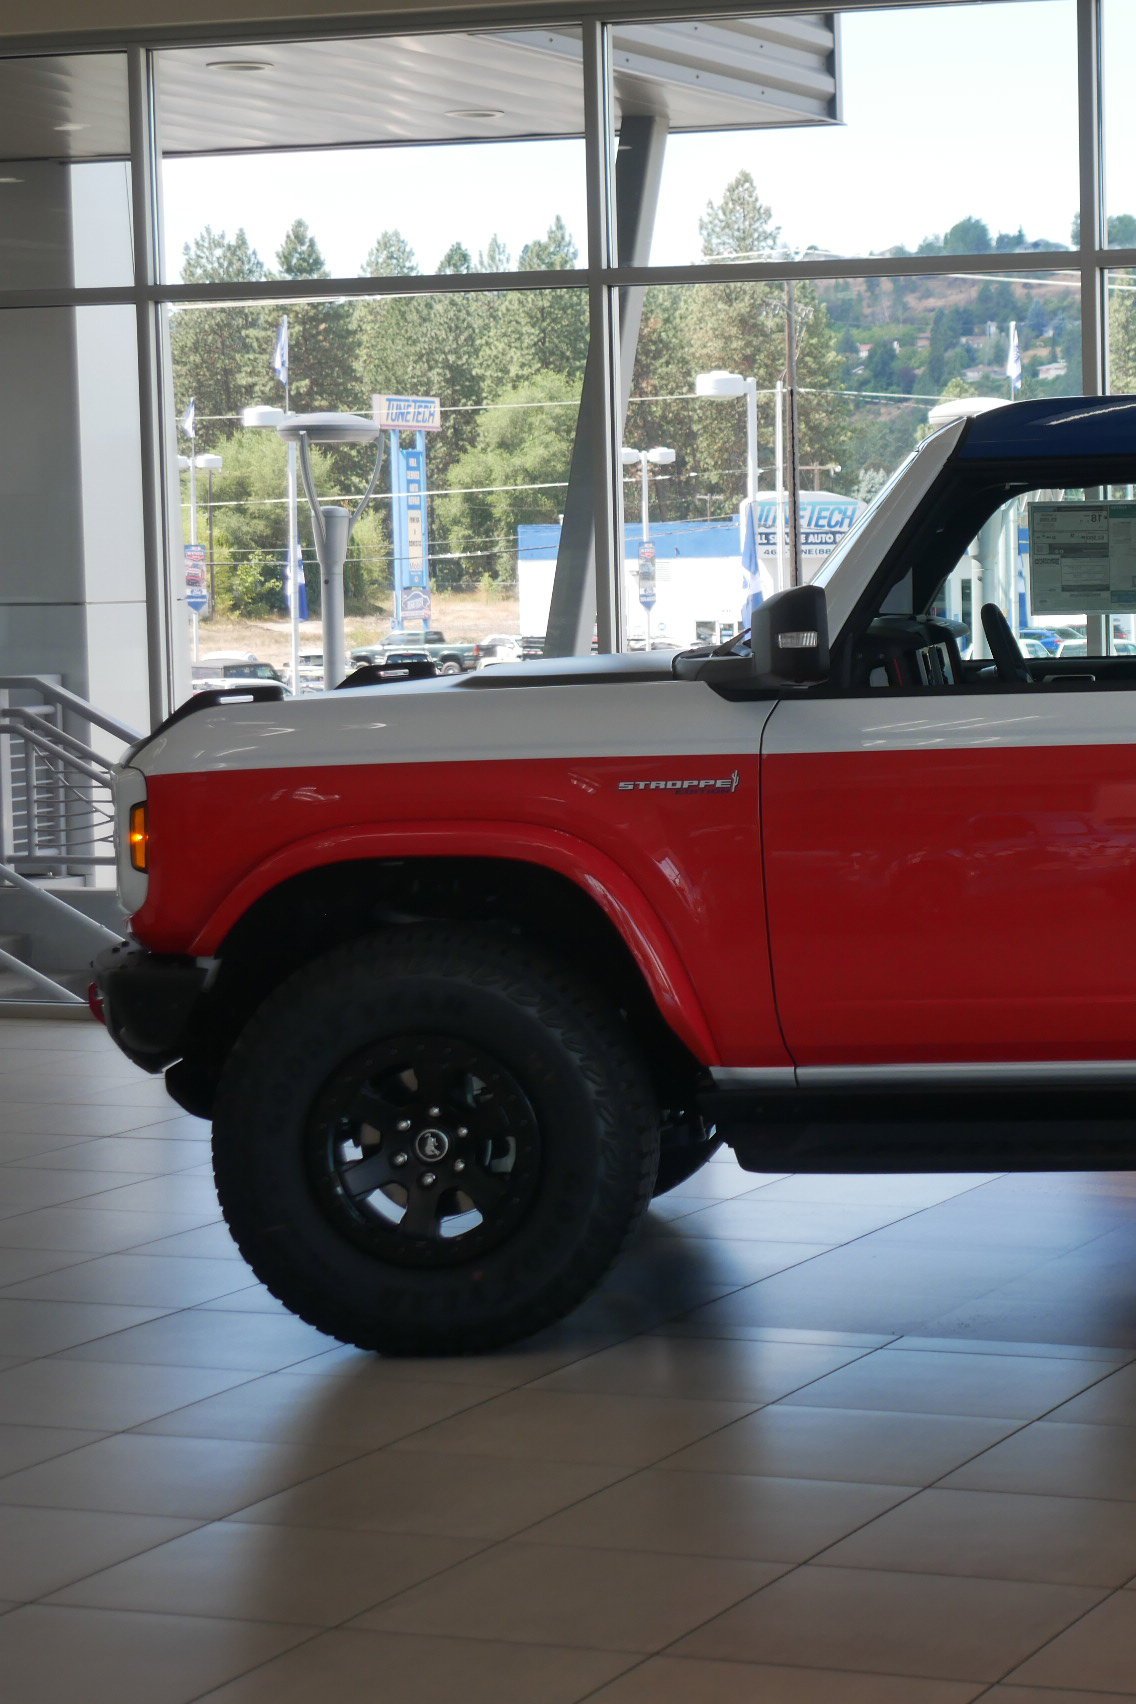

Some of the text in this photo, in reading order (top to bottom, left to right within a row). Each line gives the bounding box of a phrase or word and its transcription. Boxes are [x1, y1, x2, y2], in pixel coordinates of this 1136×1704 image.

[757, 501, 858, 529] TUTECH
[807, 535, 834, 543] AUTO
[618, 779, 732, 790] STROPPE
